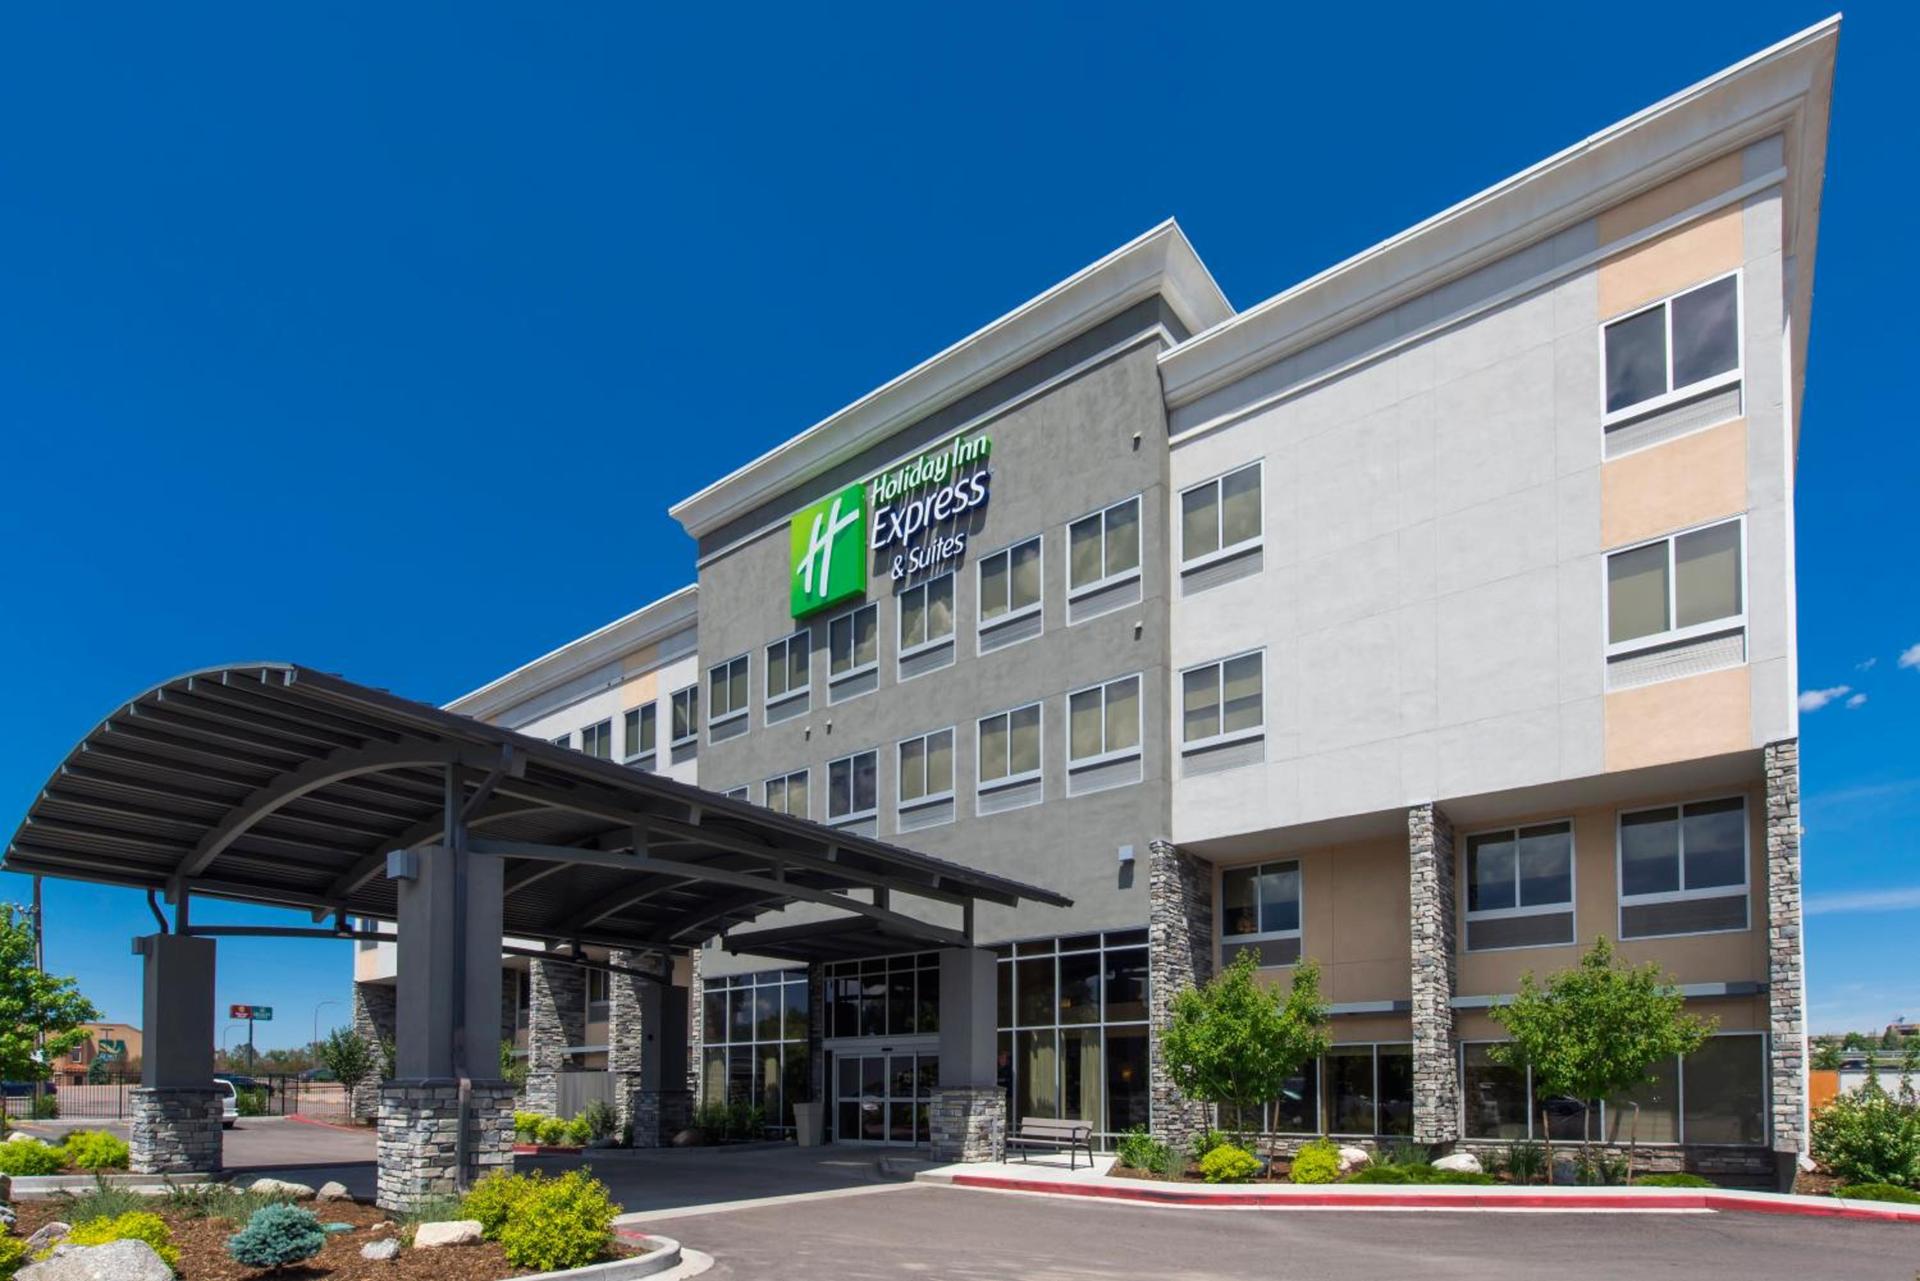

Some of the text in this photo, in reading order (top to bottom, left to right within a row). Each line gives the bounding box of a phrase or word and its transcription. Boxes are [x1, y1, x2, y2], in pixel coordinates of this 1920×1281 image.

[871, 435, 987, 506] Holiday Inn
[870, 470, 986, 549] Express
[891, 533, 965, 580] & Suites
